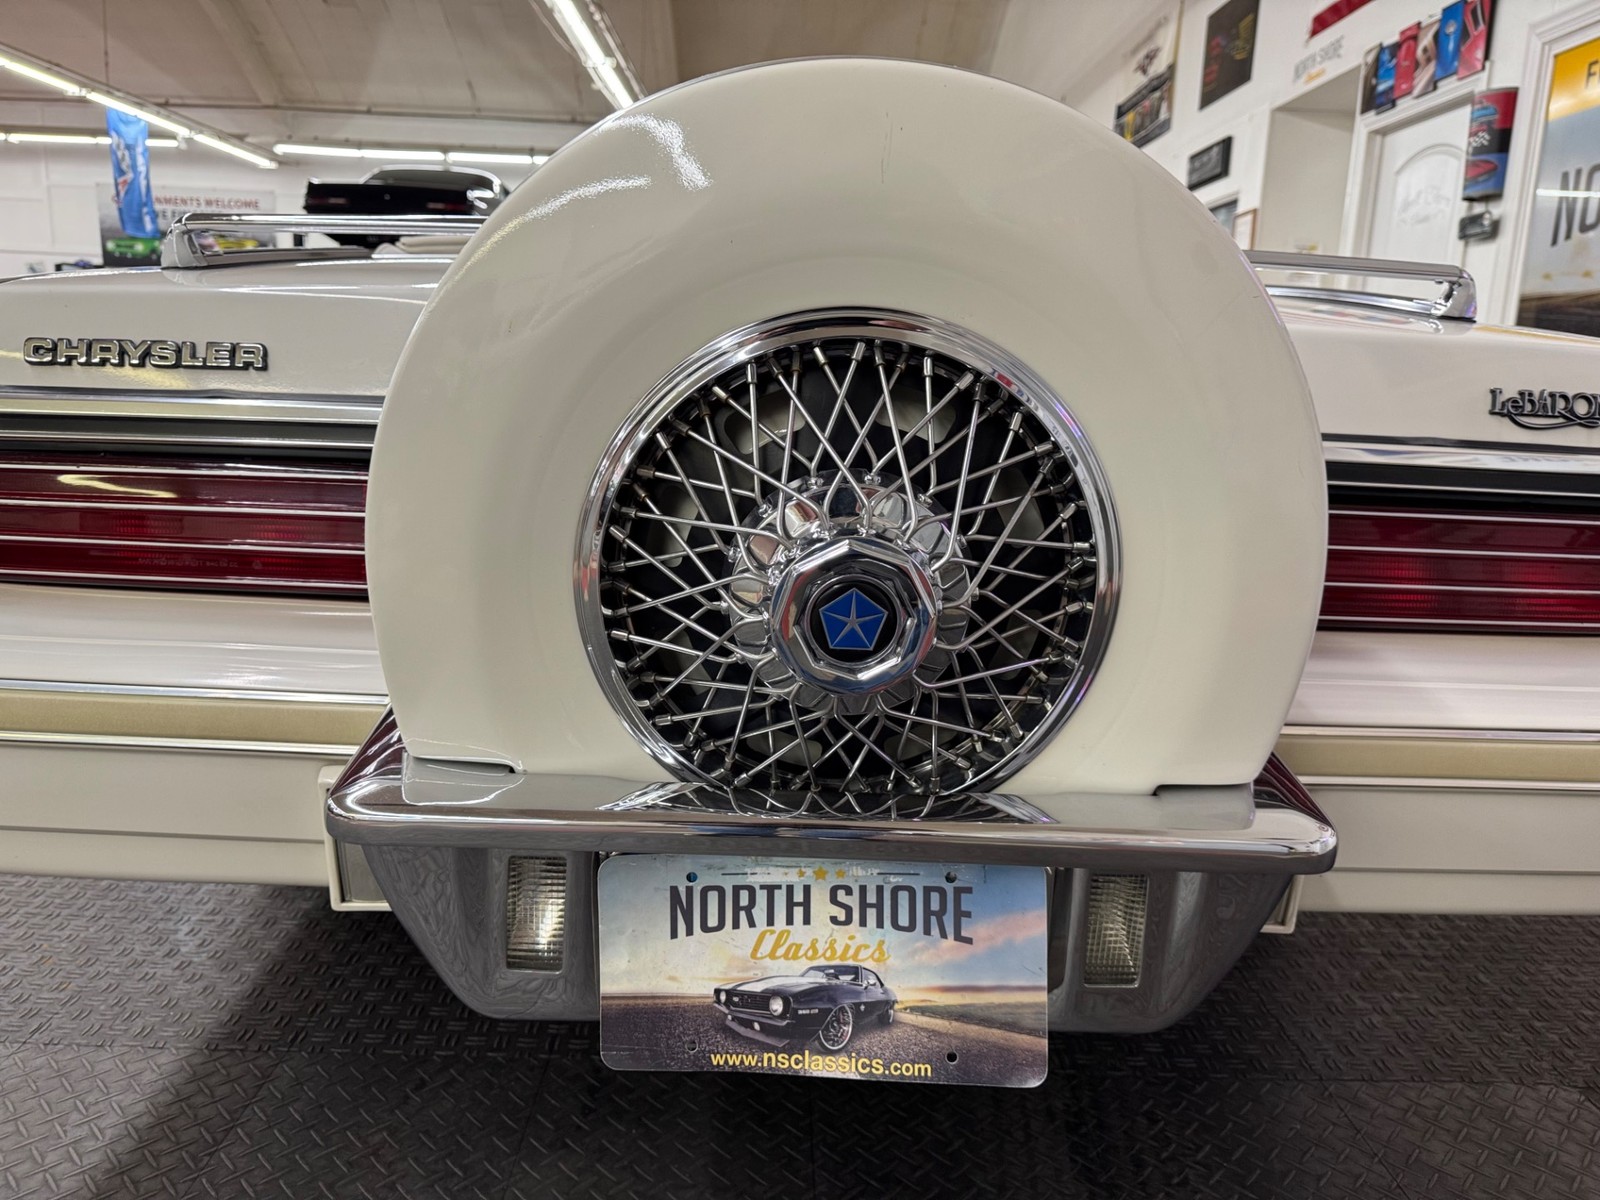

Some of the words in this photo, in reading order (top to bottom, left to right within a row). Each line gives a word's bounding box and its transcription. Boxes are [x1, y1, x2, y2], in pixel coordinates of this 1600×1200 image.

[1584, 58, 1600, 90] F
[204, 197, 260, 210] WELCOME
[23, 337, 268, 371] CHRYSLER
[669, 884, 811, 940] NORTH
[829, 884, 973, 946] SHORE
[750, 928, 892, 964] Classics
[710, 1050, 933, 1077] www.nsclassics.com
